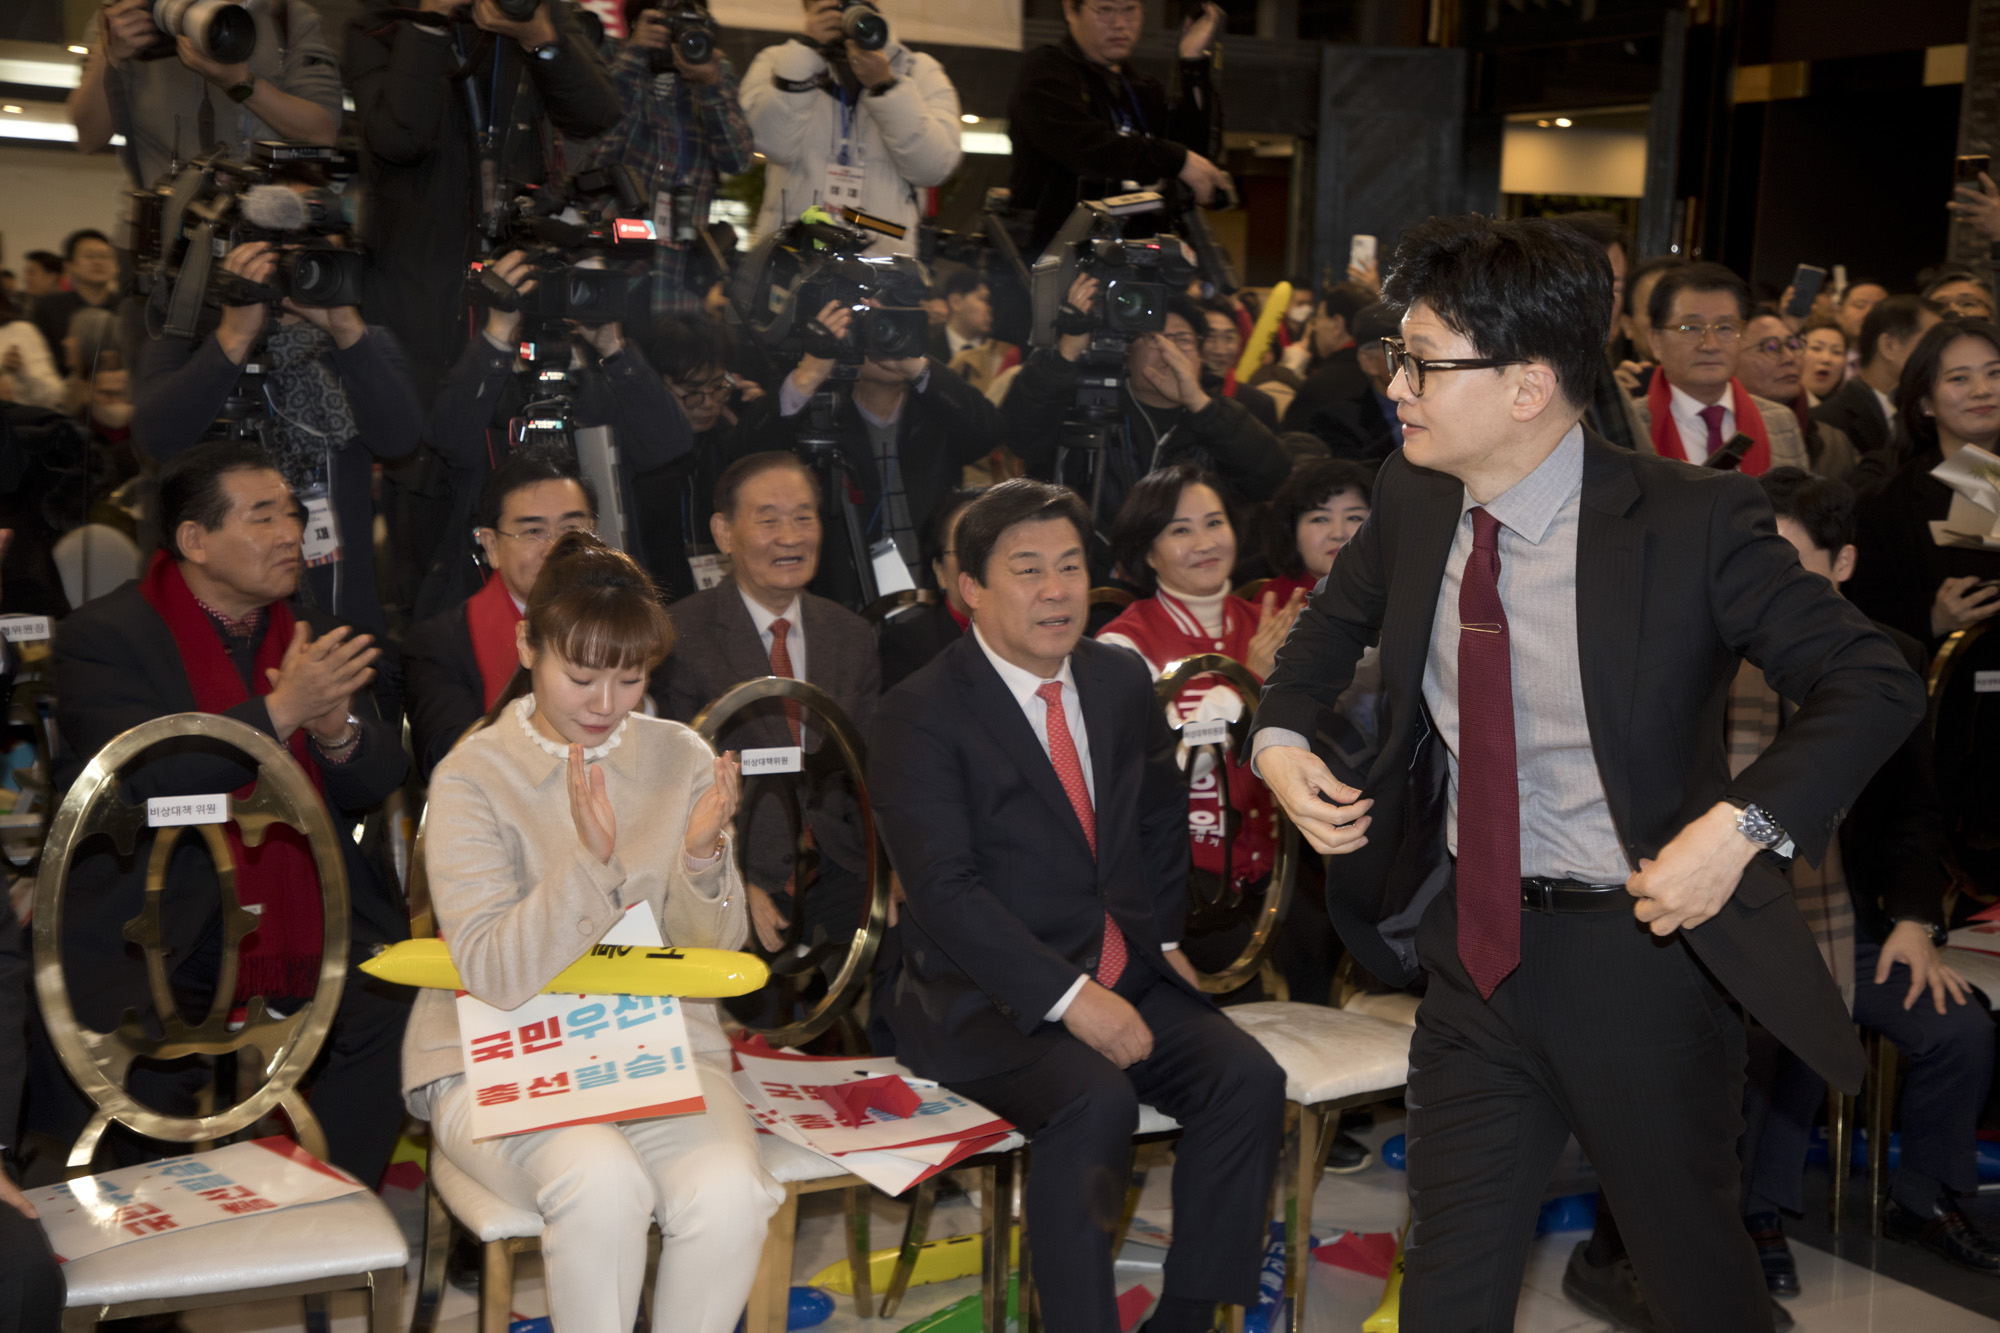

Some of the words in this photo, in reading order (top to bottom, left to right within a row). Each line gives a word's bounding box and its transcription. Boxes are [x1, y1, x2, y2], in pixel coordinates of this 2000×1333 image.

[743, 756, 788, 767] 비상대책위원
[149, 805, 192, 818] 비상대책
[195, 803, 216, 815] 위원
